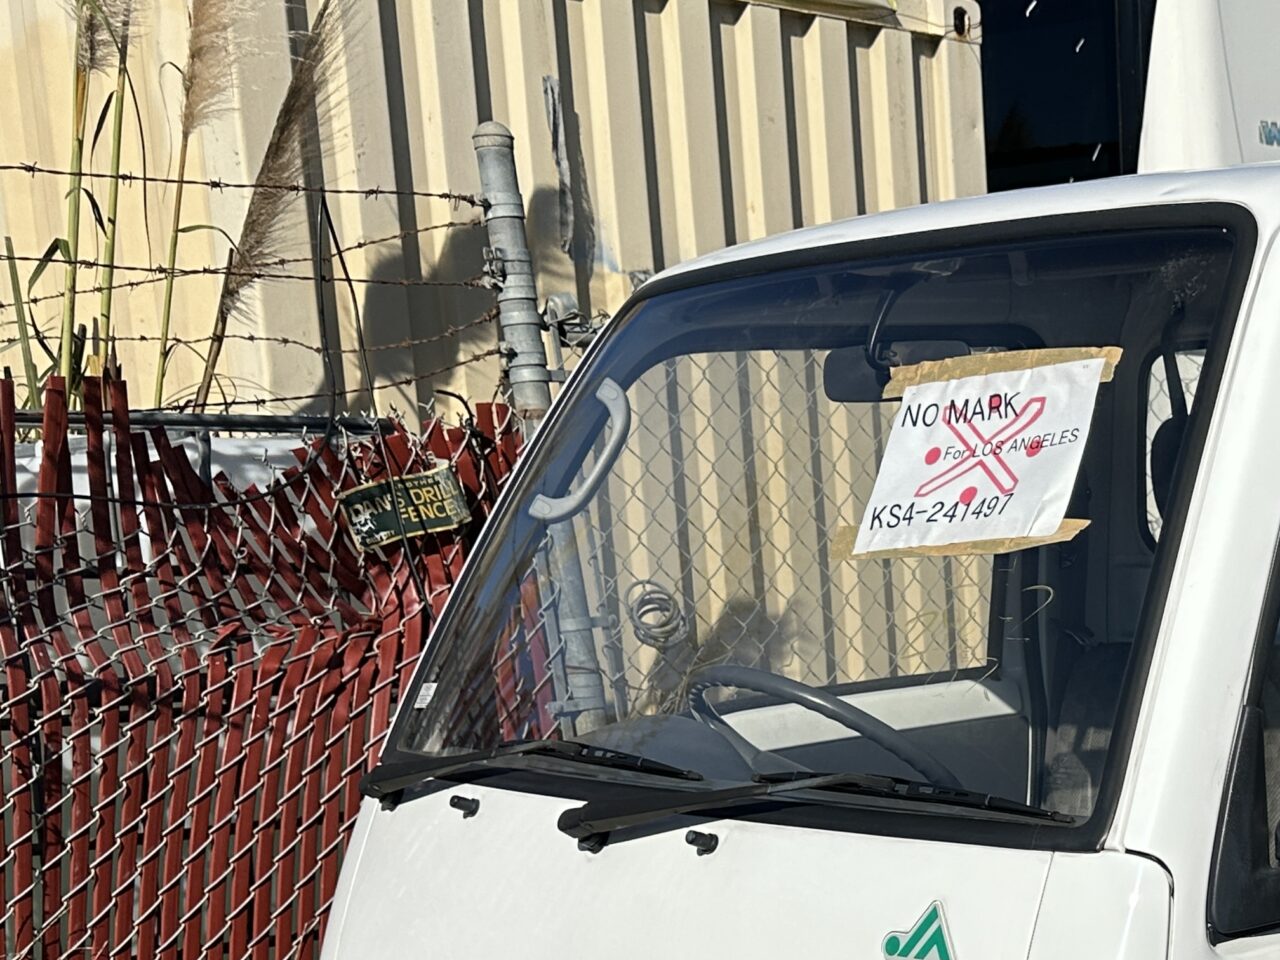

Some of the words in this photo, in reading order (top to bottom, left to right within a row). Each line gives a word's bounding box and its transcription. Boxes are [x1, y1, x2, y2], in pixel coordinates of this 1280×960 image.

[901, 404, 939, 428] NO
[948, 391, 1021, 424] MARK
[943, 445, 968, 461] For
[972, 441, 1004, 458] LOS
[1007, 428, 1080, 454] ANGELES
[410, 484, 460, 505] DRILL
[401, 501, 458, 523] FENCE
[869, 493, 1014, 531] KS4-241497
